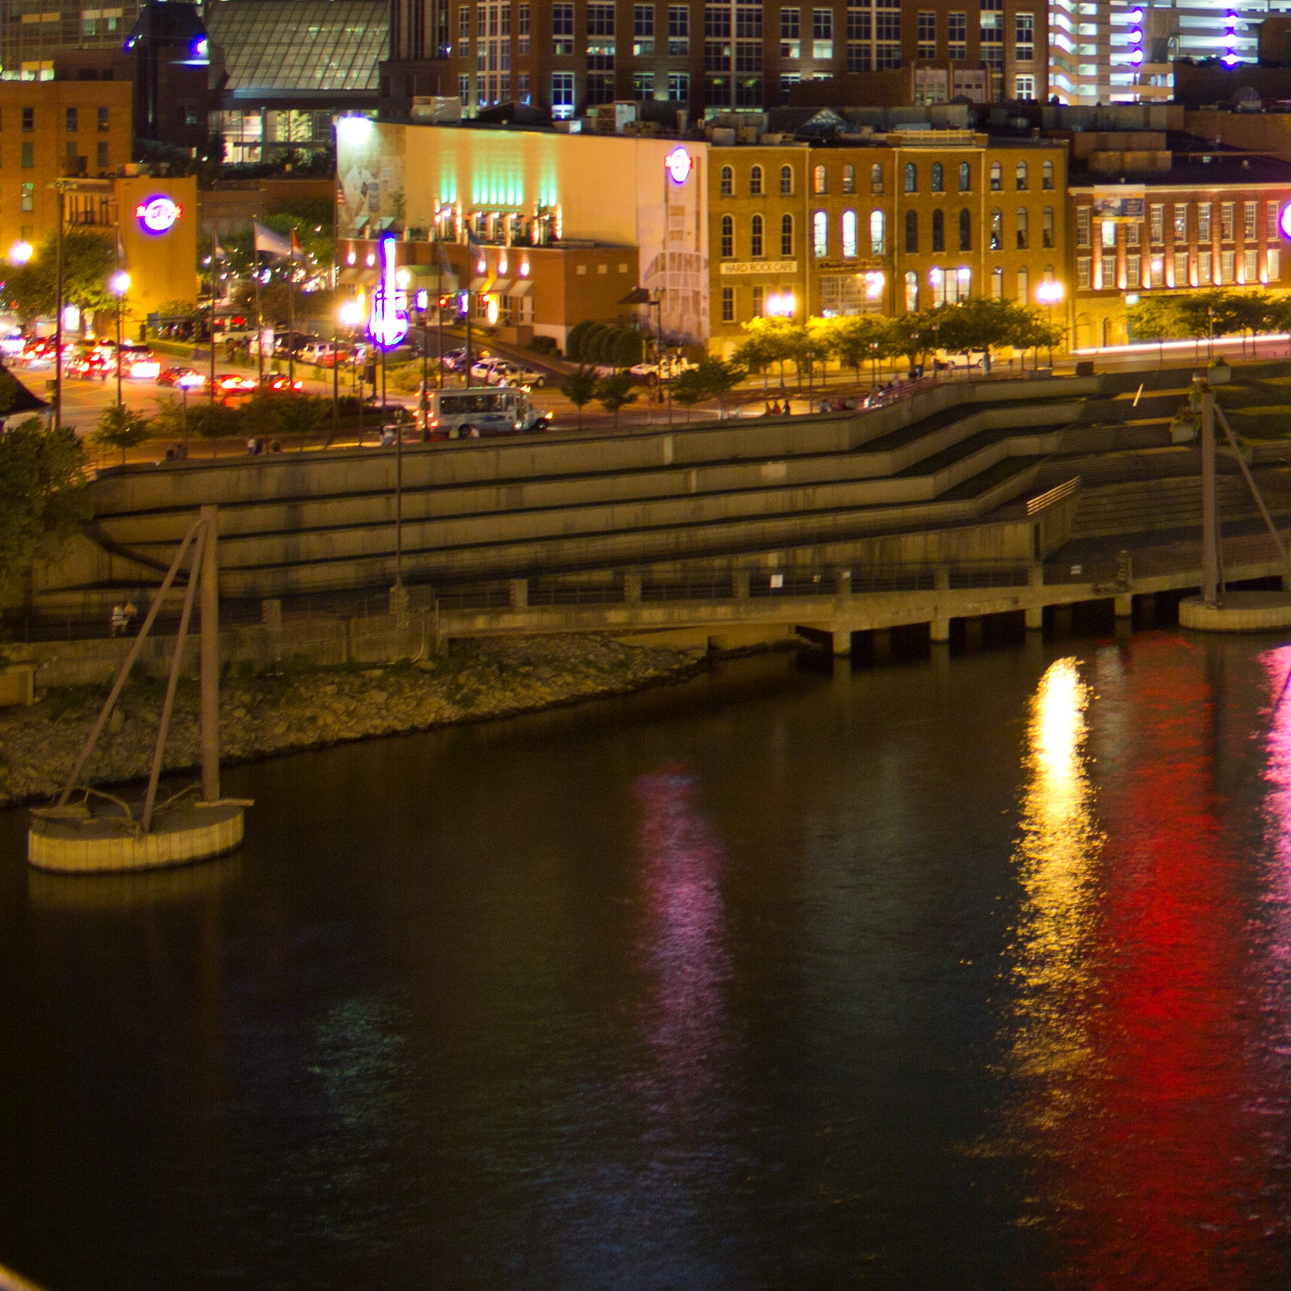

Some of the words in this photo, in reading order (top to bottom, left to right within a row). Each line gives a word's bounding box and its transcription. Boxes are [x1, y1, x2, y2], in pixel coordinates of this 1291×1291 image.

[725, 263, 748, 272] HARD
[750, 263, 771, 272] ROCK
[773, 262, 793, 271] CAFE
